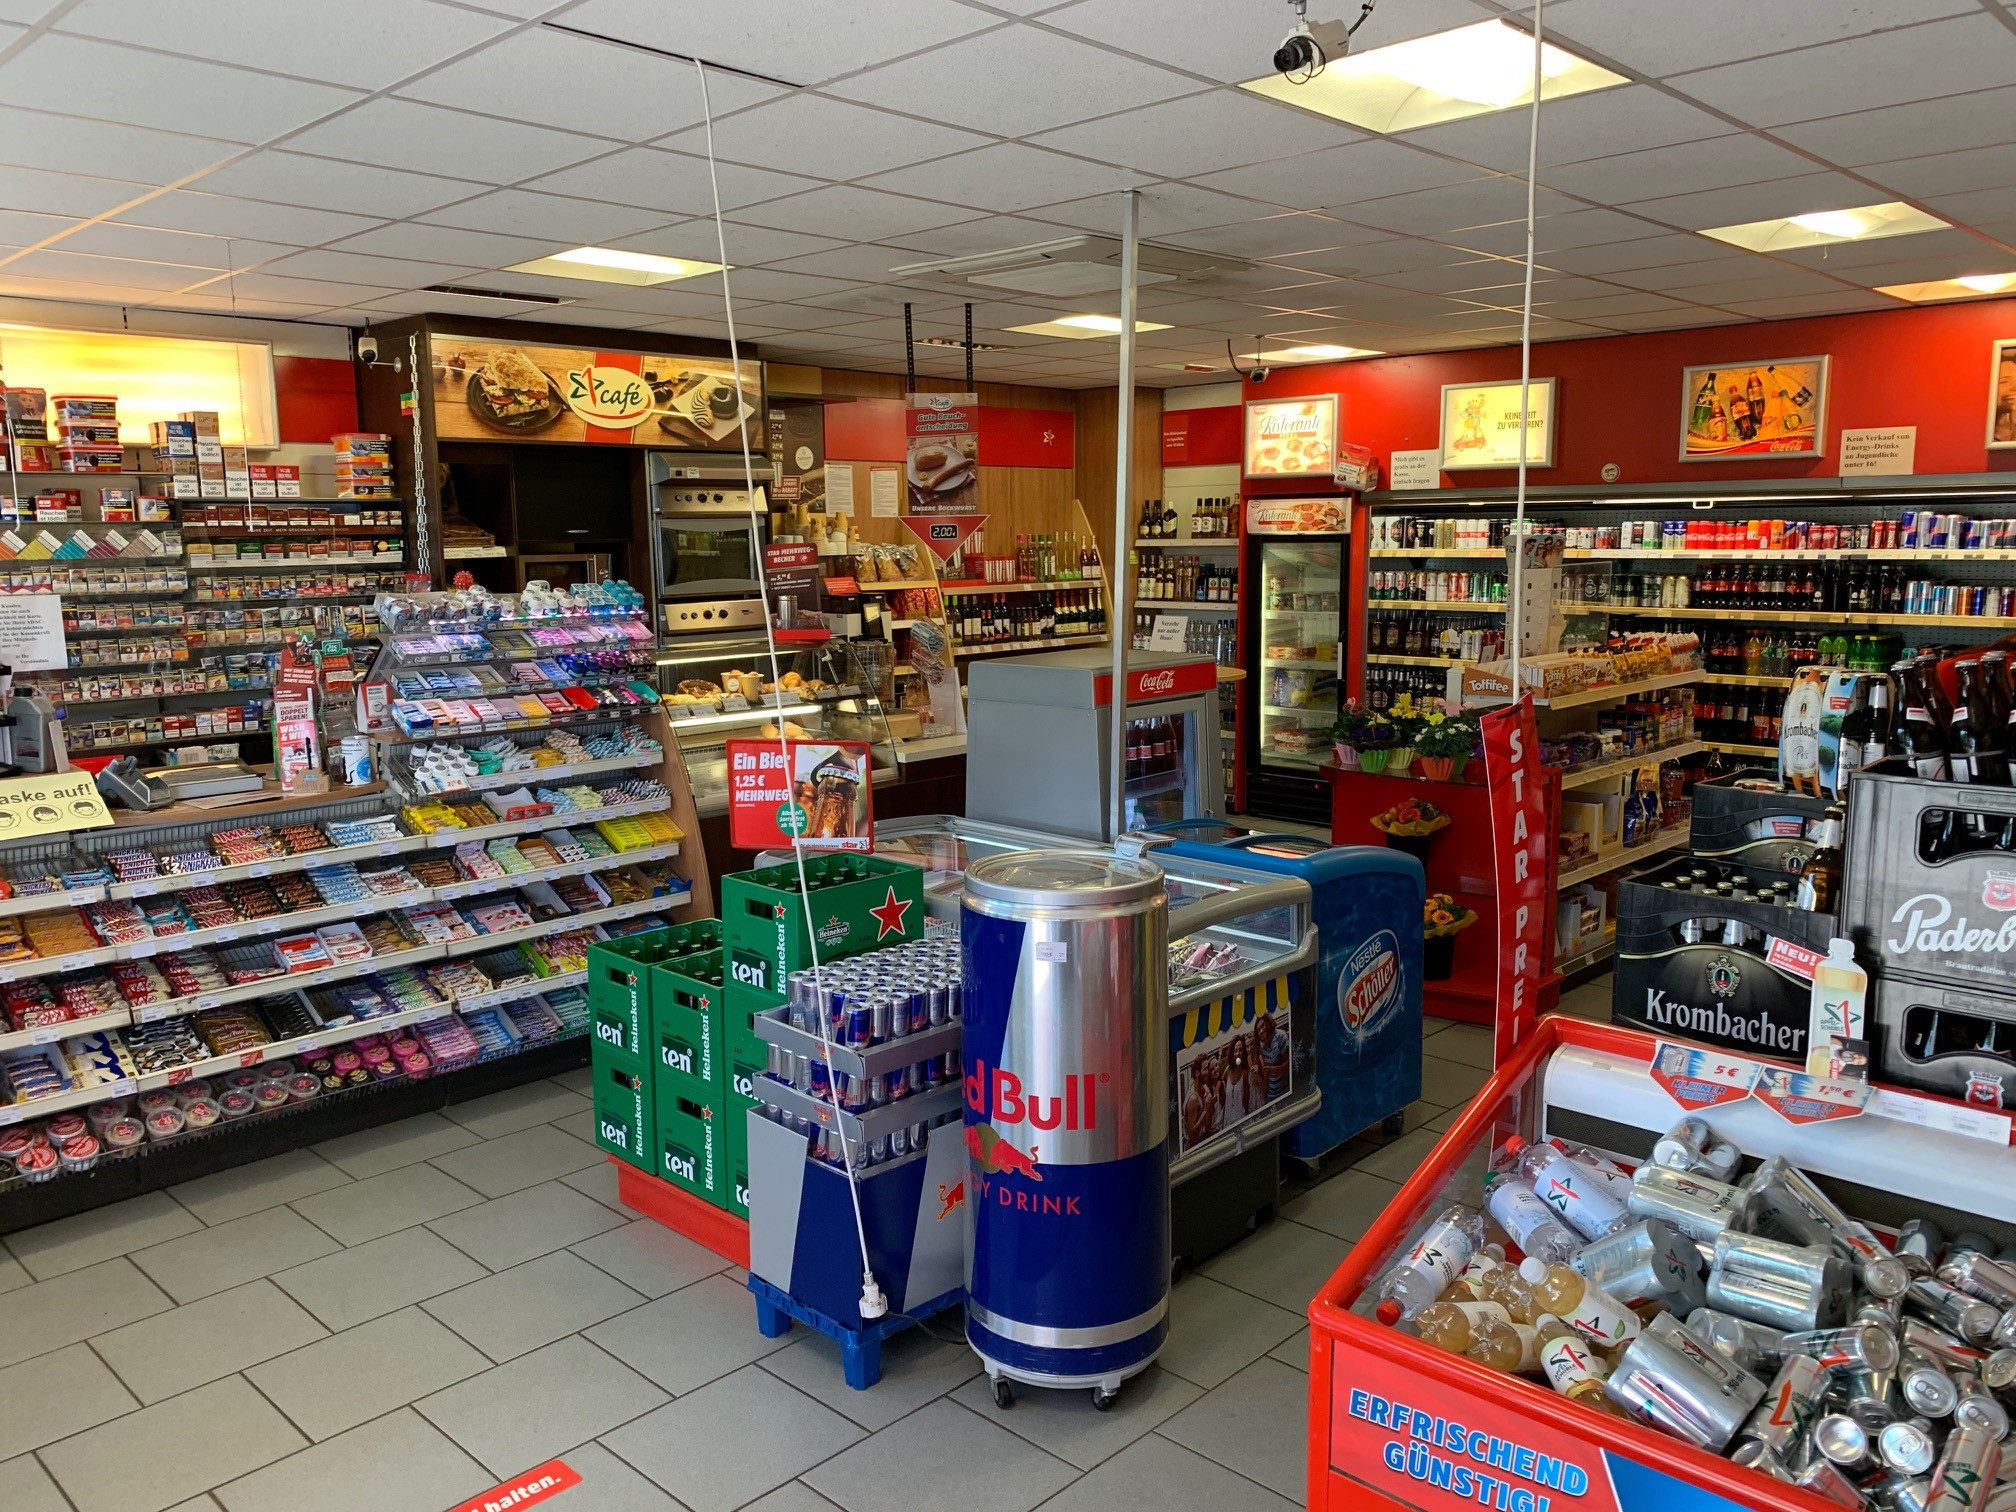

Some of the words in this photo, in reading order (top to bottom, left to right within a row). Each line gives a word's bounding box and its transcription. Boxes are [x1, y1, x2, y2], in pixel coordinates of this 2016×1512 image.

[600, 382, 644, 414] café
[916, 422, 968, 432] entscheidung
[1497, 422, 1506, 430] ZU
[1866, 434, 1894, 442] Verkauf
[1846, 443, 1900, 452] Energy-Drinks
[1856, 452, 1898, 460] Jugendliche
[1469, 679, 1509, 693] Toffifee
[1784, 721, 1818, 740] Krombacher
[734, 753, 756, 770] Ein
[734, 775, 755, 788] 1,25
[757, 775, 765, 787] €
[53, 783, 92, 799] auf!
[736, 789, 790, 801] MEHRWEG
[1510, 728, 1528, 884] STAR
[819, 926, 848, 938] Heineken
[777, 922, 786, 995] Heineken
[1350, 937, 1382, 976] Nestlé
[1776, 942, 1816, 967] NEU!
[1945, 960, 2006, 976] Brautradition
[1348, 956, 1395, 1028] Schöller
[1646, 988, 1806, 1052] Krombacher
[1714, 1065, 1725, 1074] 5
[1727, 1067, 1739, 1077] €
[1671, 1079, 1726, 1095] KLEINER
[1818, 1084, 1842, 1096] 1,50
[1843, 1088, 1856, 1098] €
[992, 1068, 1096, 1131] Bull
[1778, 1097, 1837, 1112] KLEINER
[635, 1094, 643, 1157] Heineken
[705, 1125, 714, 1191] Heineken
[999, 1186, 1082, 1216] DRINK
[1348, 1387, 1589, 1497] ERFRISCHEND
[1383, 1440, 1551, 1512] GÜNSTIG!
[484, 1475, 562, 1512] halten.
